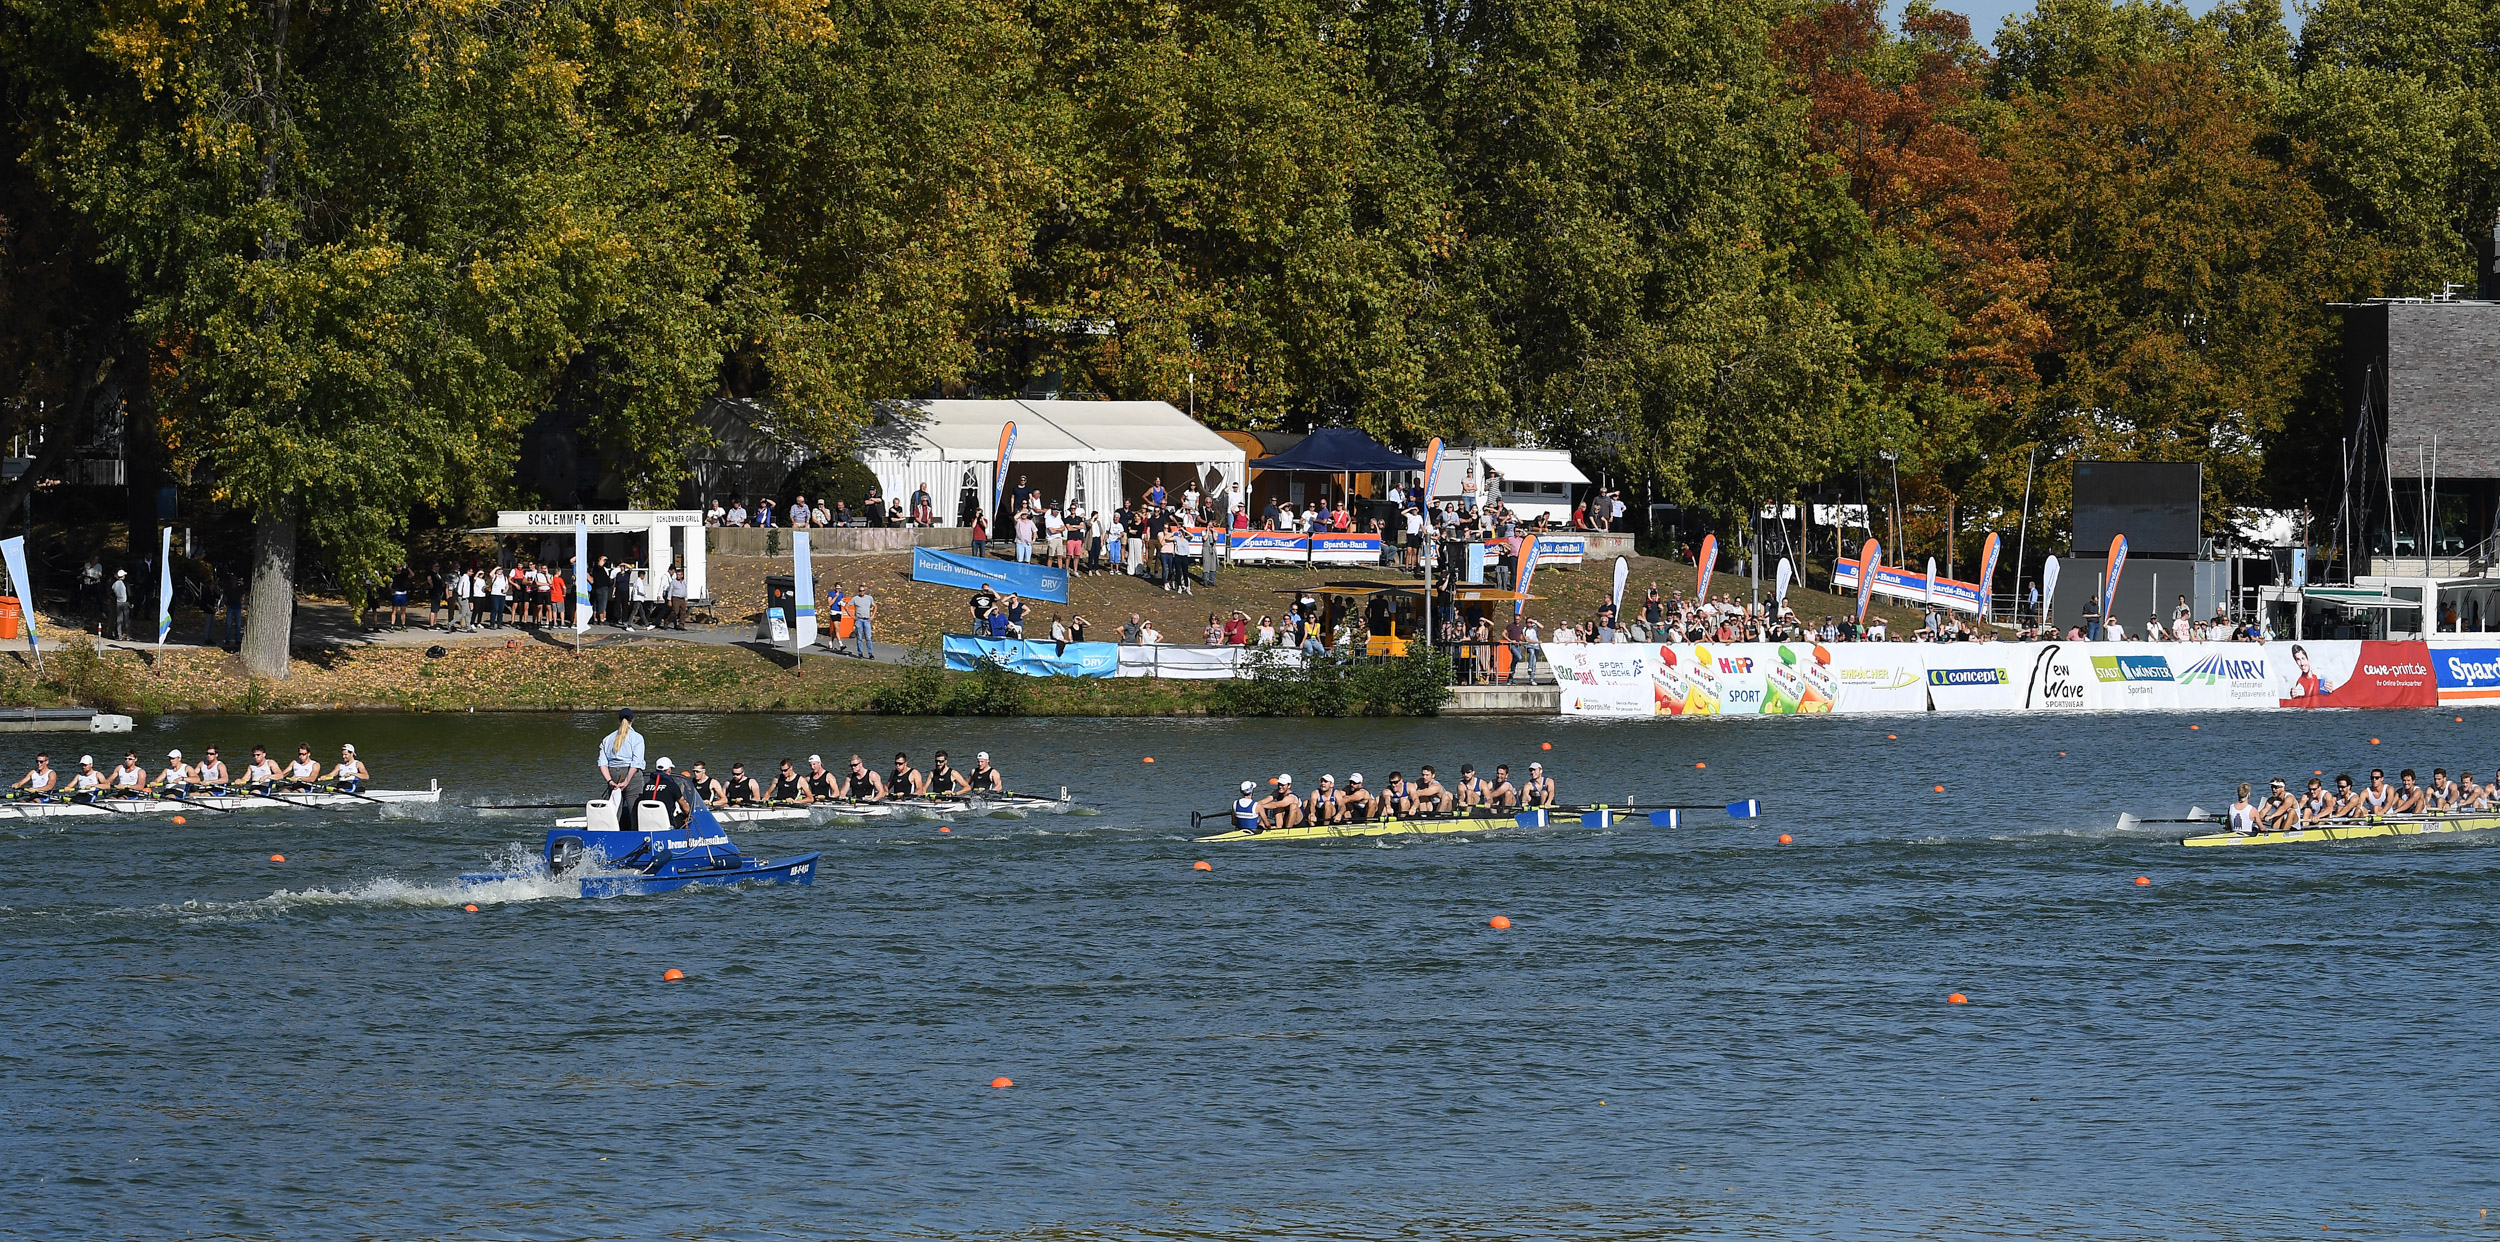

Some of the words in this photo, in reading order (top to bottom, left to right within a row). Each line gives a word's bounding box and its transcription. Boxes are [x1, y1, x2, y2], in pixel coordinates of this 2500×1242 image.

[997, 433, 1016, 490] Sparda-Bank
[528, 514, 586, 525] SCHLEMMER
[593, 514, 620, 525] GRILL
[656, 515, 685, 523] SCHLEMMER
[686, 515, 700, 523] GRILL
[1323, 540, 1368, 549] Sparda-Bank
[919, 559, 953, 573] Herzlich
[1980, 543, 2000, 598] Sparda-Bank
[2106, 545, 2126, 598] Sparda-Bank
[1041, 578, 1057, 589] DRV
[1858, 551, 1880, 607] Sparda-Bank
[1932, 584, 1976, 600] parda-Bank
[1083, 658, 1104, 667] DRV
[1718, 657, 1754, 674] HiPP
[2225, 660, 2265, 679] MRV
[2364, 663, 2427, 677] cewe-print.de
[1660, 667, 1679, 682] HiPP
[1694, 667, 1714, 682] HiPP
[1776, 667, 1797, 683] HiPP
[1811, 667, 1830, 683] HiPP
[1840, 668, 1889, 680] EMPACHER
[2096, 667, 2121, 678] STADT
[2131, 664, 2172, 678] MÜNSTER
[1729, 690, 1760, 702] SPORT
[2045, 679, 2084, 698] Wave
